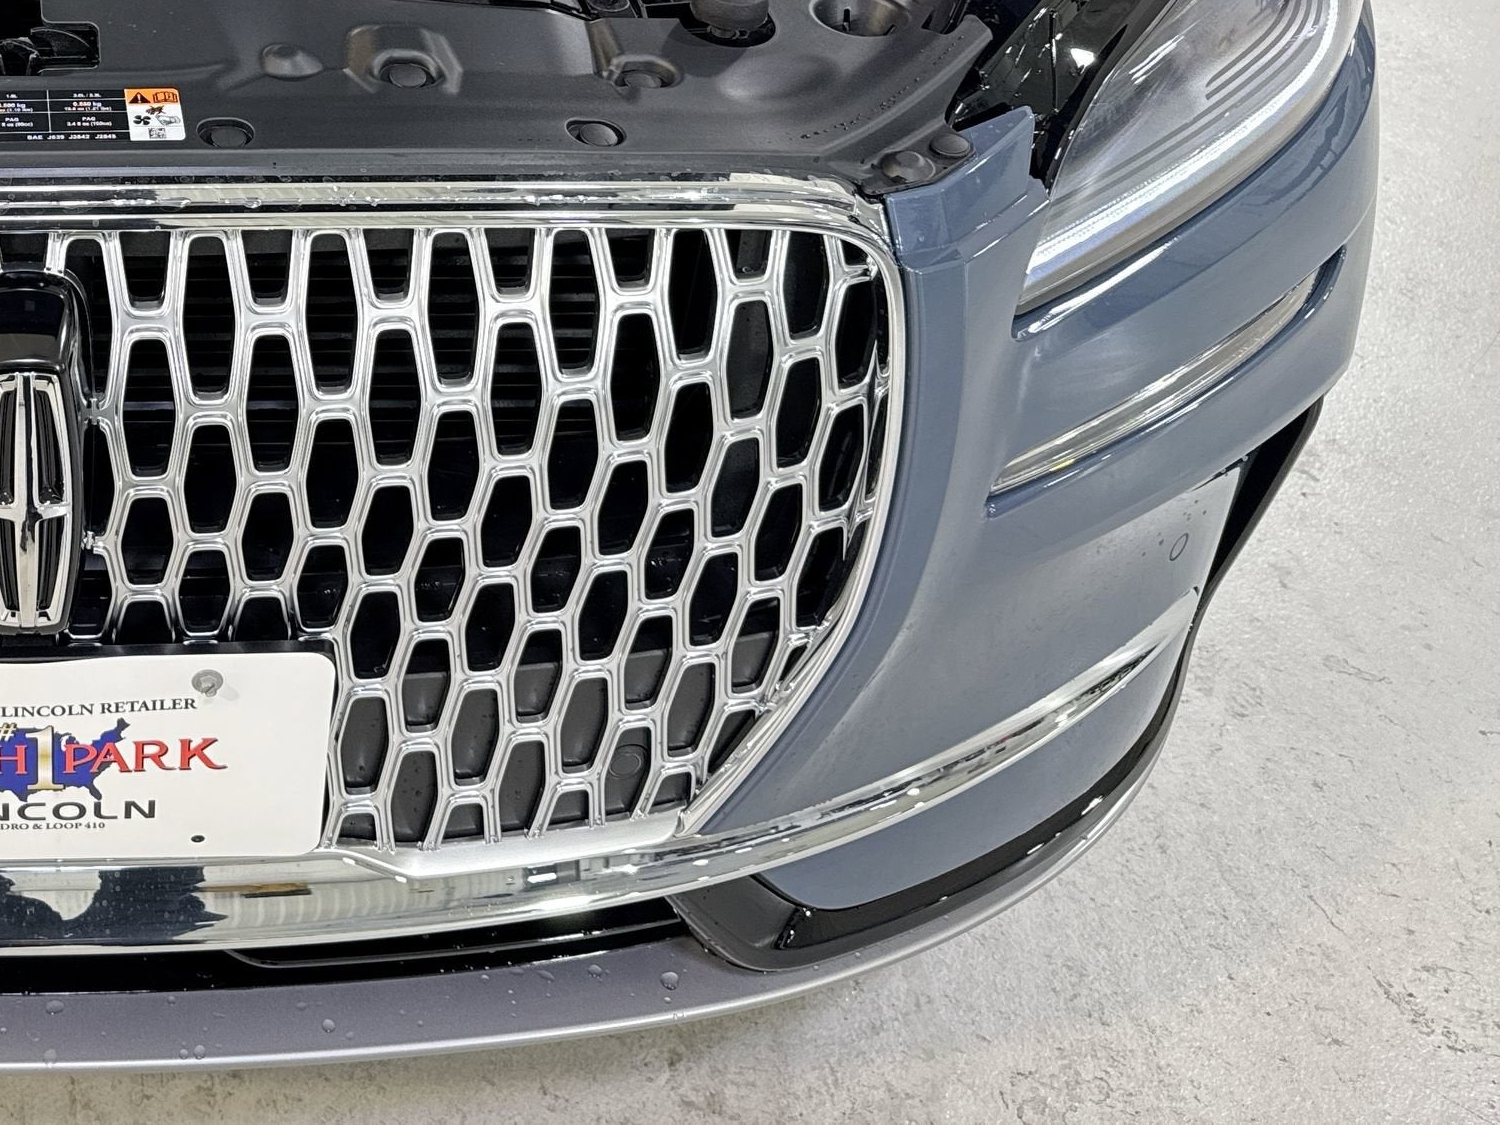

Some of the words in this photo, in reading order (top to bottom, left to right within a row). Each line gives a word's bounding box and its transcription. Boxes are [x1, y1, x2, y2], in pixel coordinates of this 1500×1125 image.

[1, 704, 95, 718] LINCOLN
[100, 698, 197, 714] RETAILER
[63, 737, 228, 774] PARK
[46, 822, 82, 830] LOOP
[84, 821, 105, 829] 410
